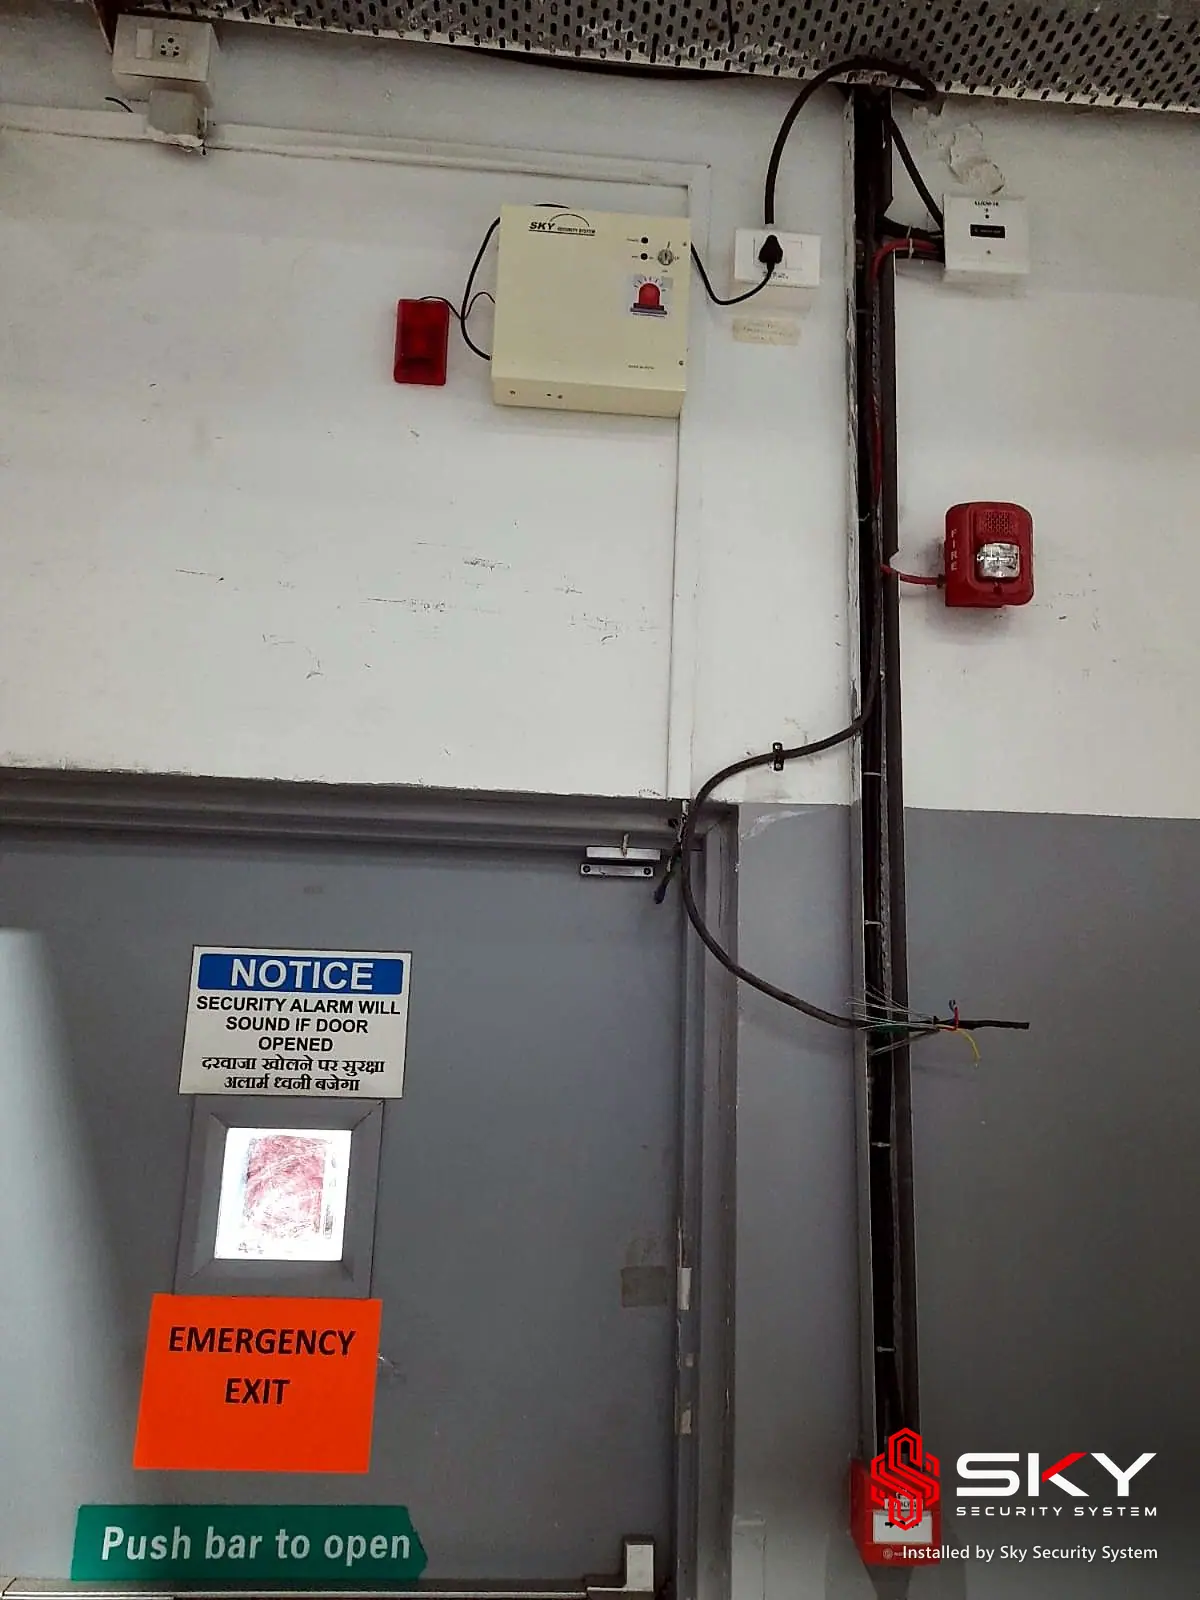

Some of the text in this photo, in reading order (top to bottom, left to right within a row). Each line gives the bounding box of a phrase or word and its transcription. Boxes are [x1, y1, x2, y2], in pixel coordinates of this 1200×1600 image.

[529, 221, 555, 231] SKY
[231, 958, 374, 990] NOTICE
[196, 996, 401, 1015] SECURITY ALARM WILL
[226, 1017, 368, 1033] SOUND IF DOOR
[258, 1037, 334, 1051] OPENED
[202, 1055, 385, 1076] दरवाजा खोलने पर सुरक्षा
[224, 1073, 361, 1091] अलार्म ध्वनी बजेगा
[168, 1326, 356, 1356] EMERGENCY
[225, 1378, 291, 1404] EXIT
[101, 1526, 410, 1566] Push bar to open
